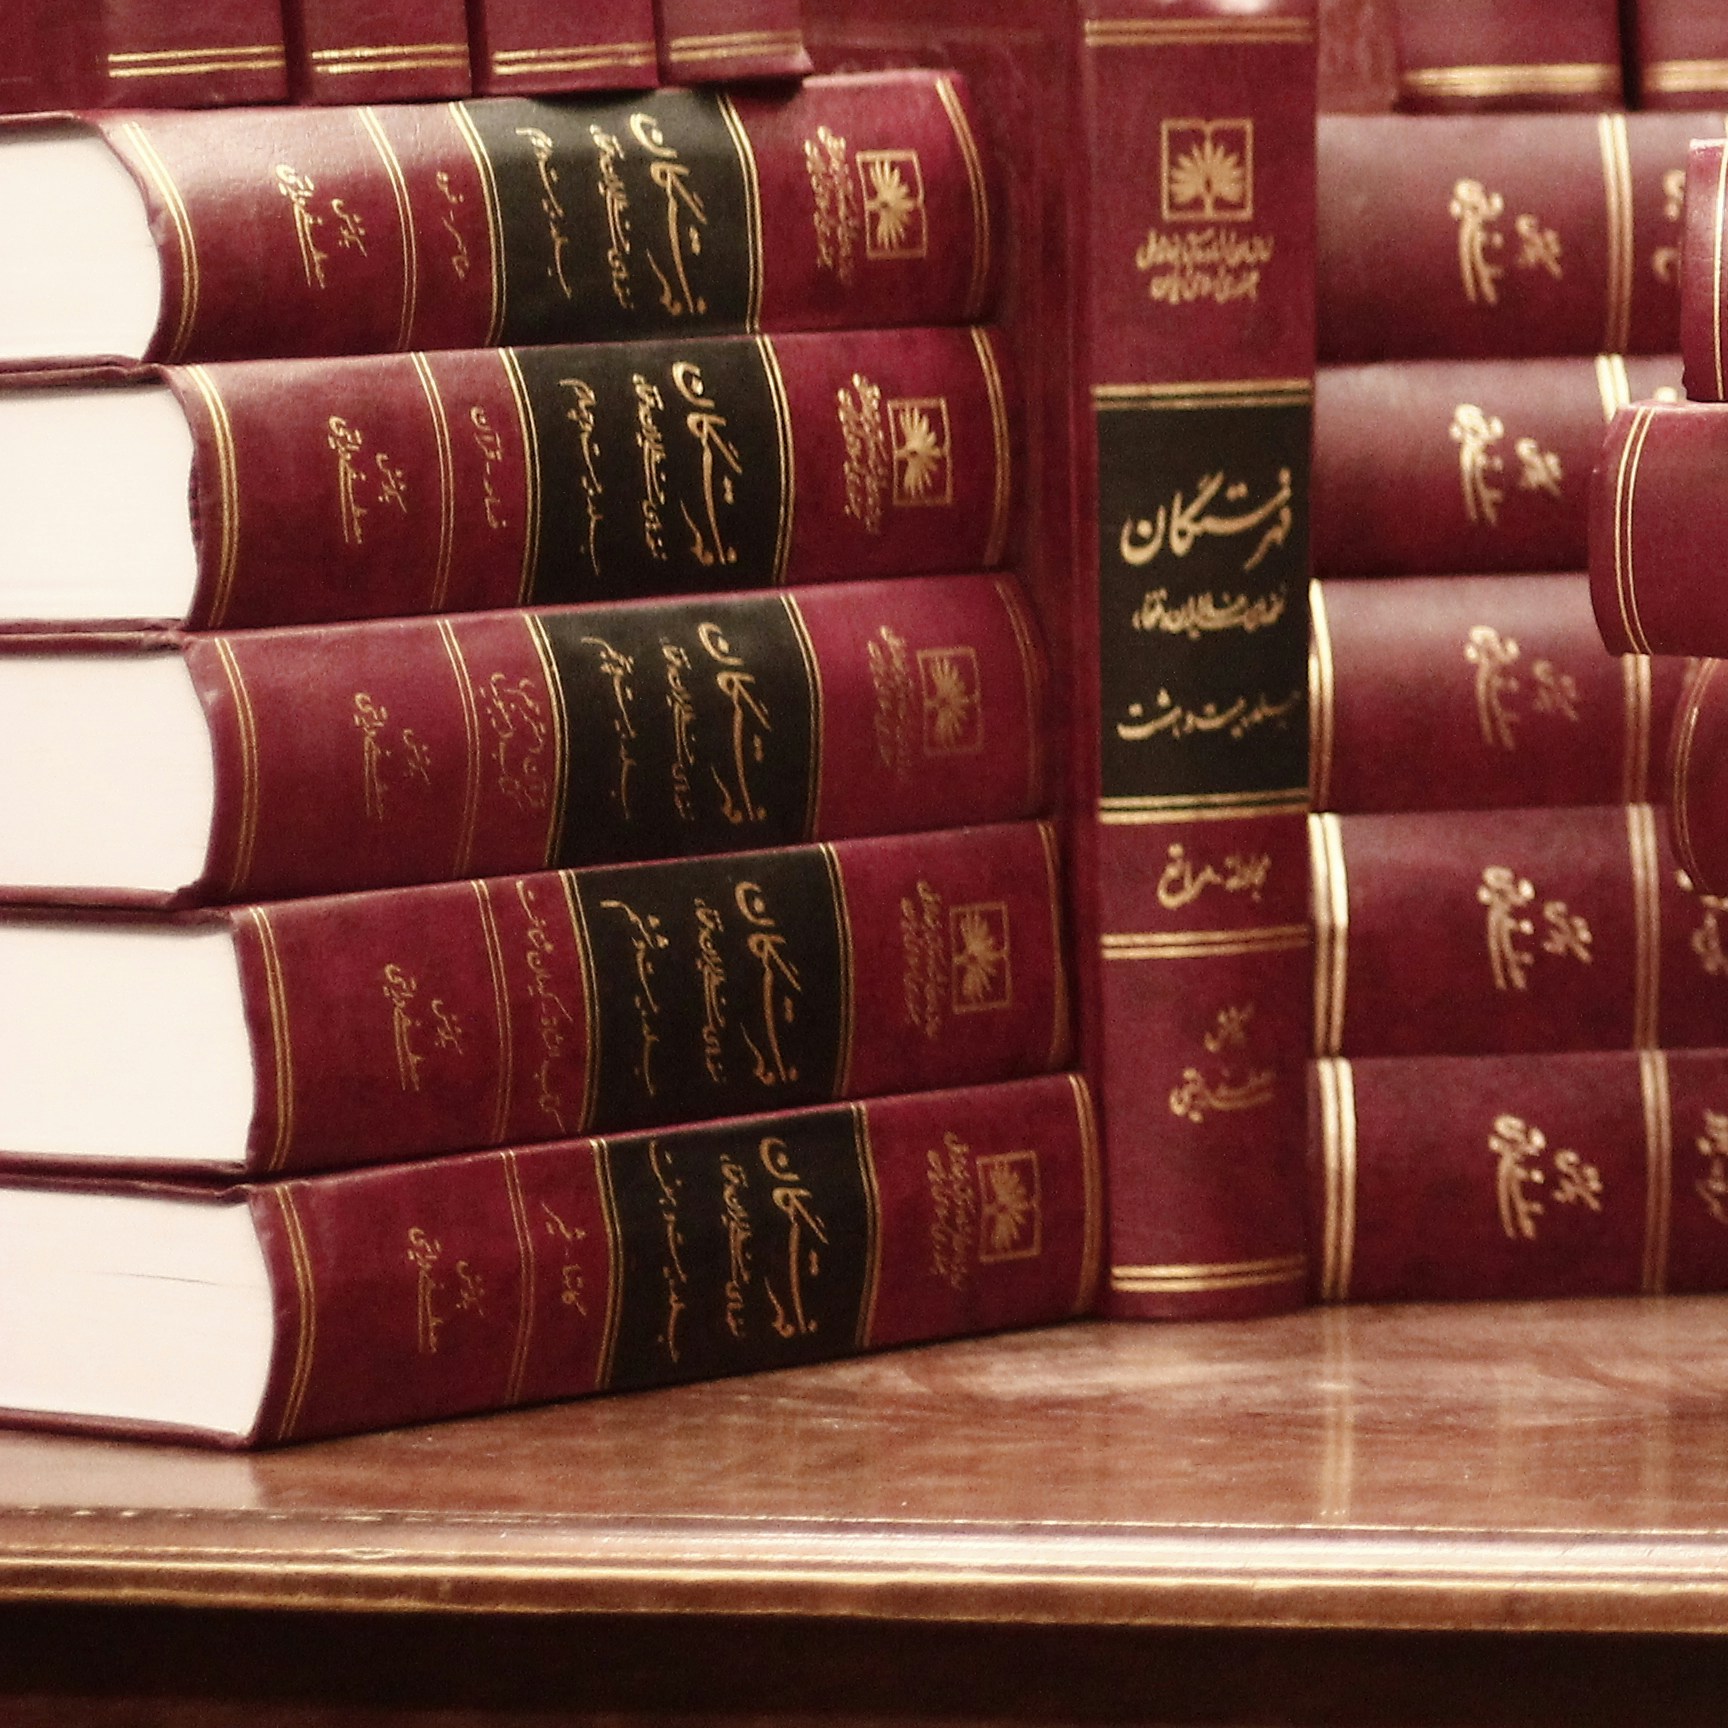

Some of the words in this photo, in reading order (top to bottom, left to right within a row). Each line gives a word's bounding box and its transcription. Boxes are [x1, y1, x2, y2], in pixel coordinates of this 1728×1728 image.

[629, 112, 709, 316] فهرستگان
[671, 360, 743, 567] فهرستگان
[1119, 466, 1293, 572] فهرستگان
[697, 621, 774, 827] فهرستگان
[734, 880, 803, 1089] فهرستگان
[758, 1135, 832, 1340] فهرستگان
